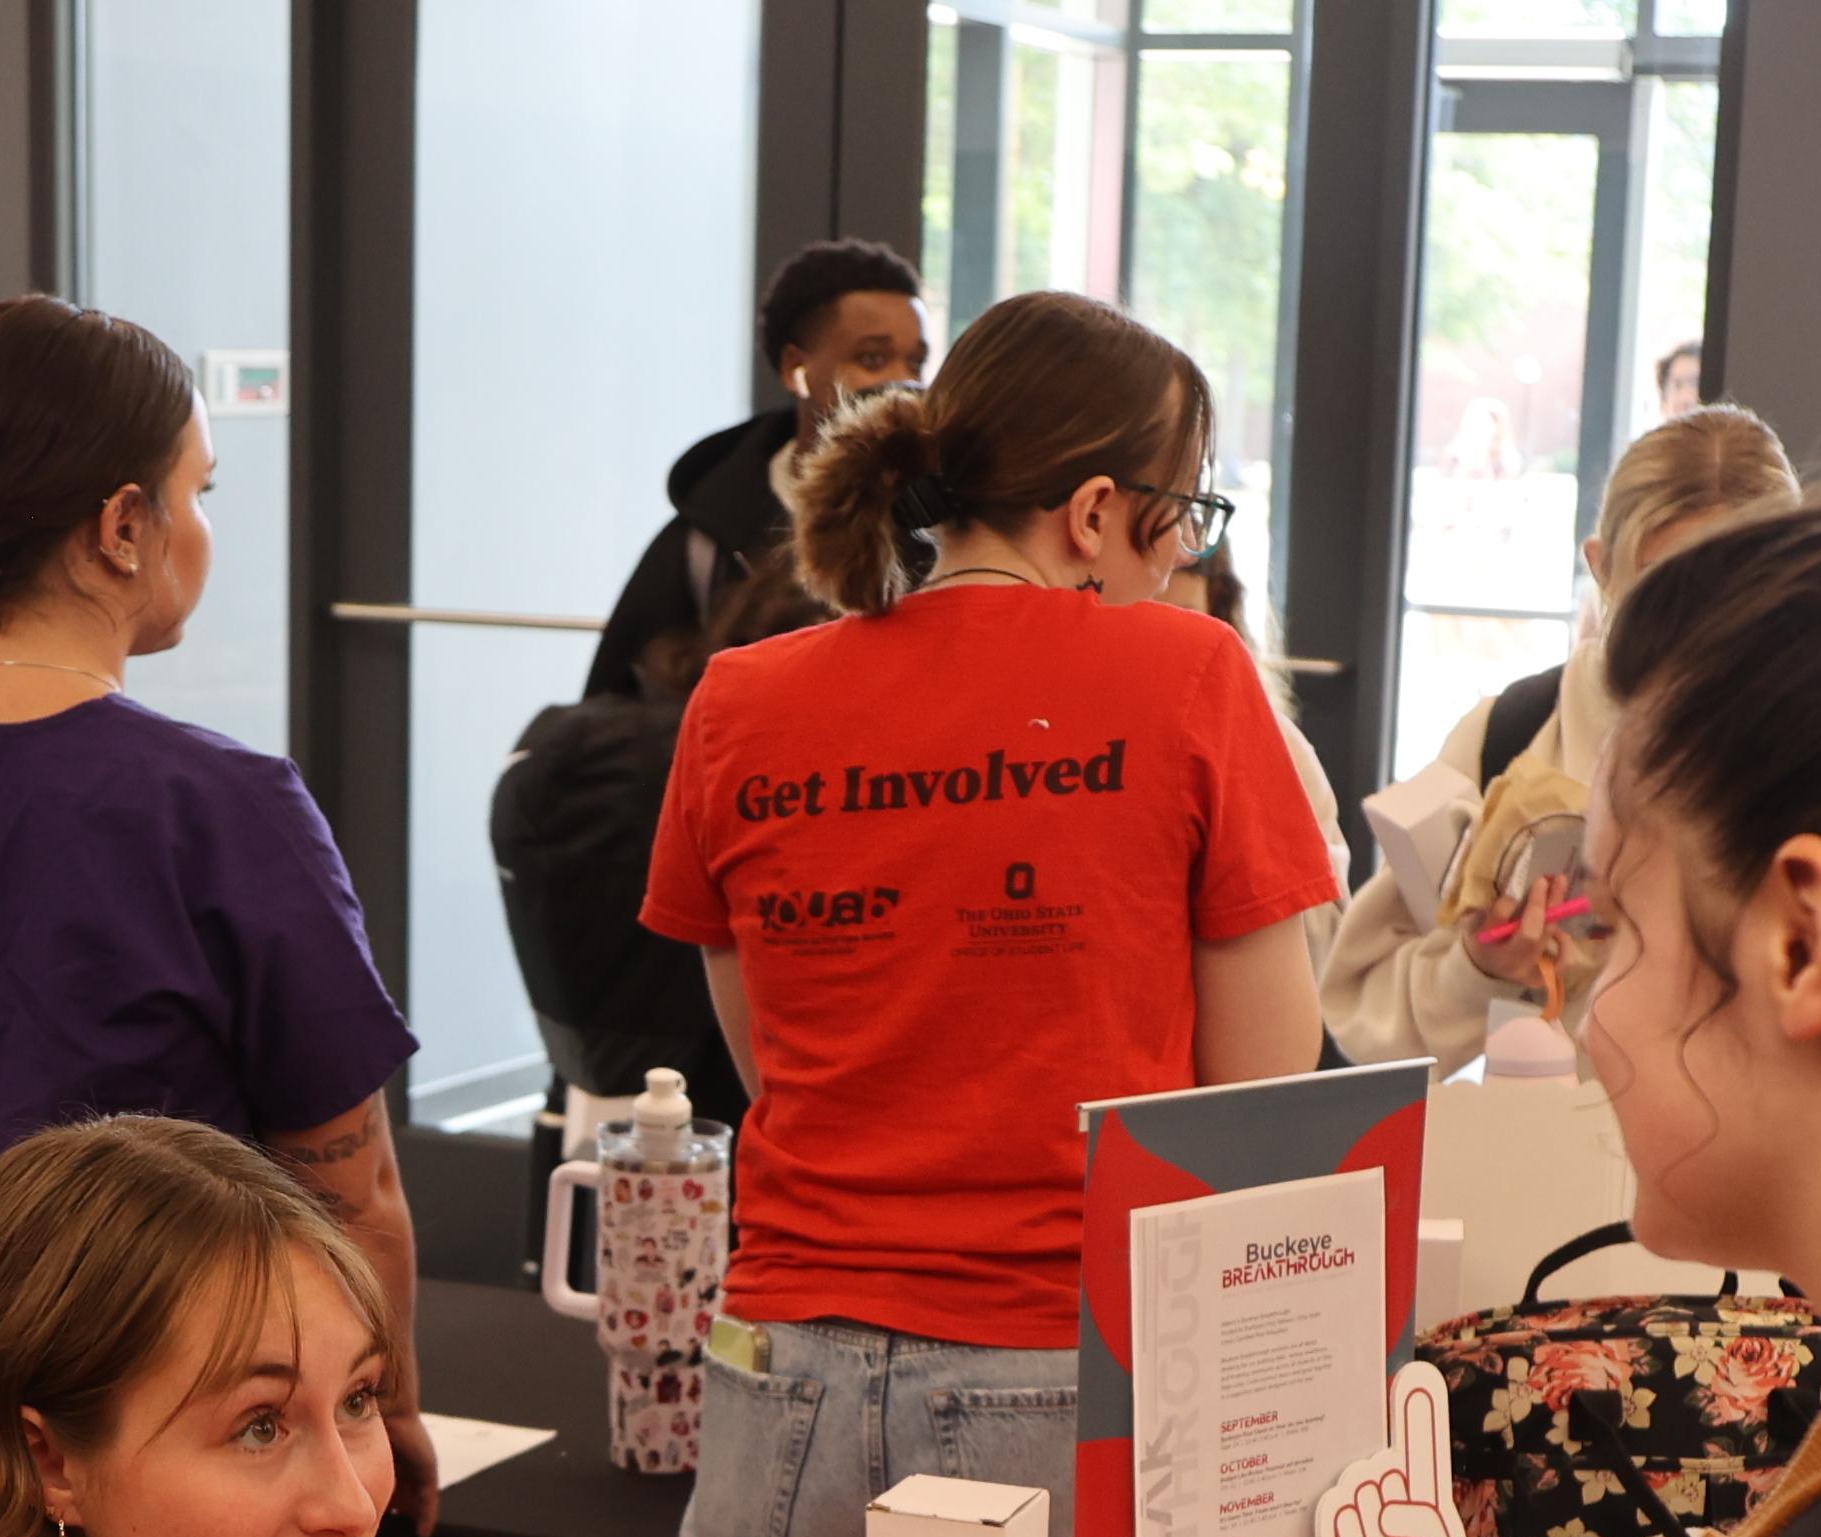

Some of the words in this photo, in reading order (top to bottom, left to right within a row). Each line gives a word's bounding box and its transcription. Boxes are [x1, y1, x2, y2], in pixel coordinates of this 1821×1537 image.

[736, 771, 826, 822] Get
[841, 740, 1126, 812] Involved
[1246, 1233, 1332, 1264] Buckeye
[1221, 1248, 1355, 1289] BREAKTHROUGH
[1220, 1410, 1279, 1433] SEPTEMBER
[1220, 1453, 1269, 1475] OCTOBER
[1219, 1491, 1275, 1515] NOVEMBER
